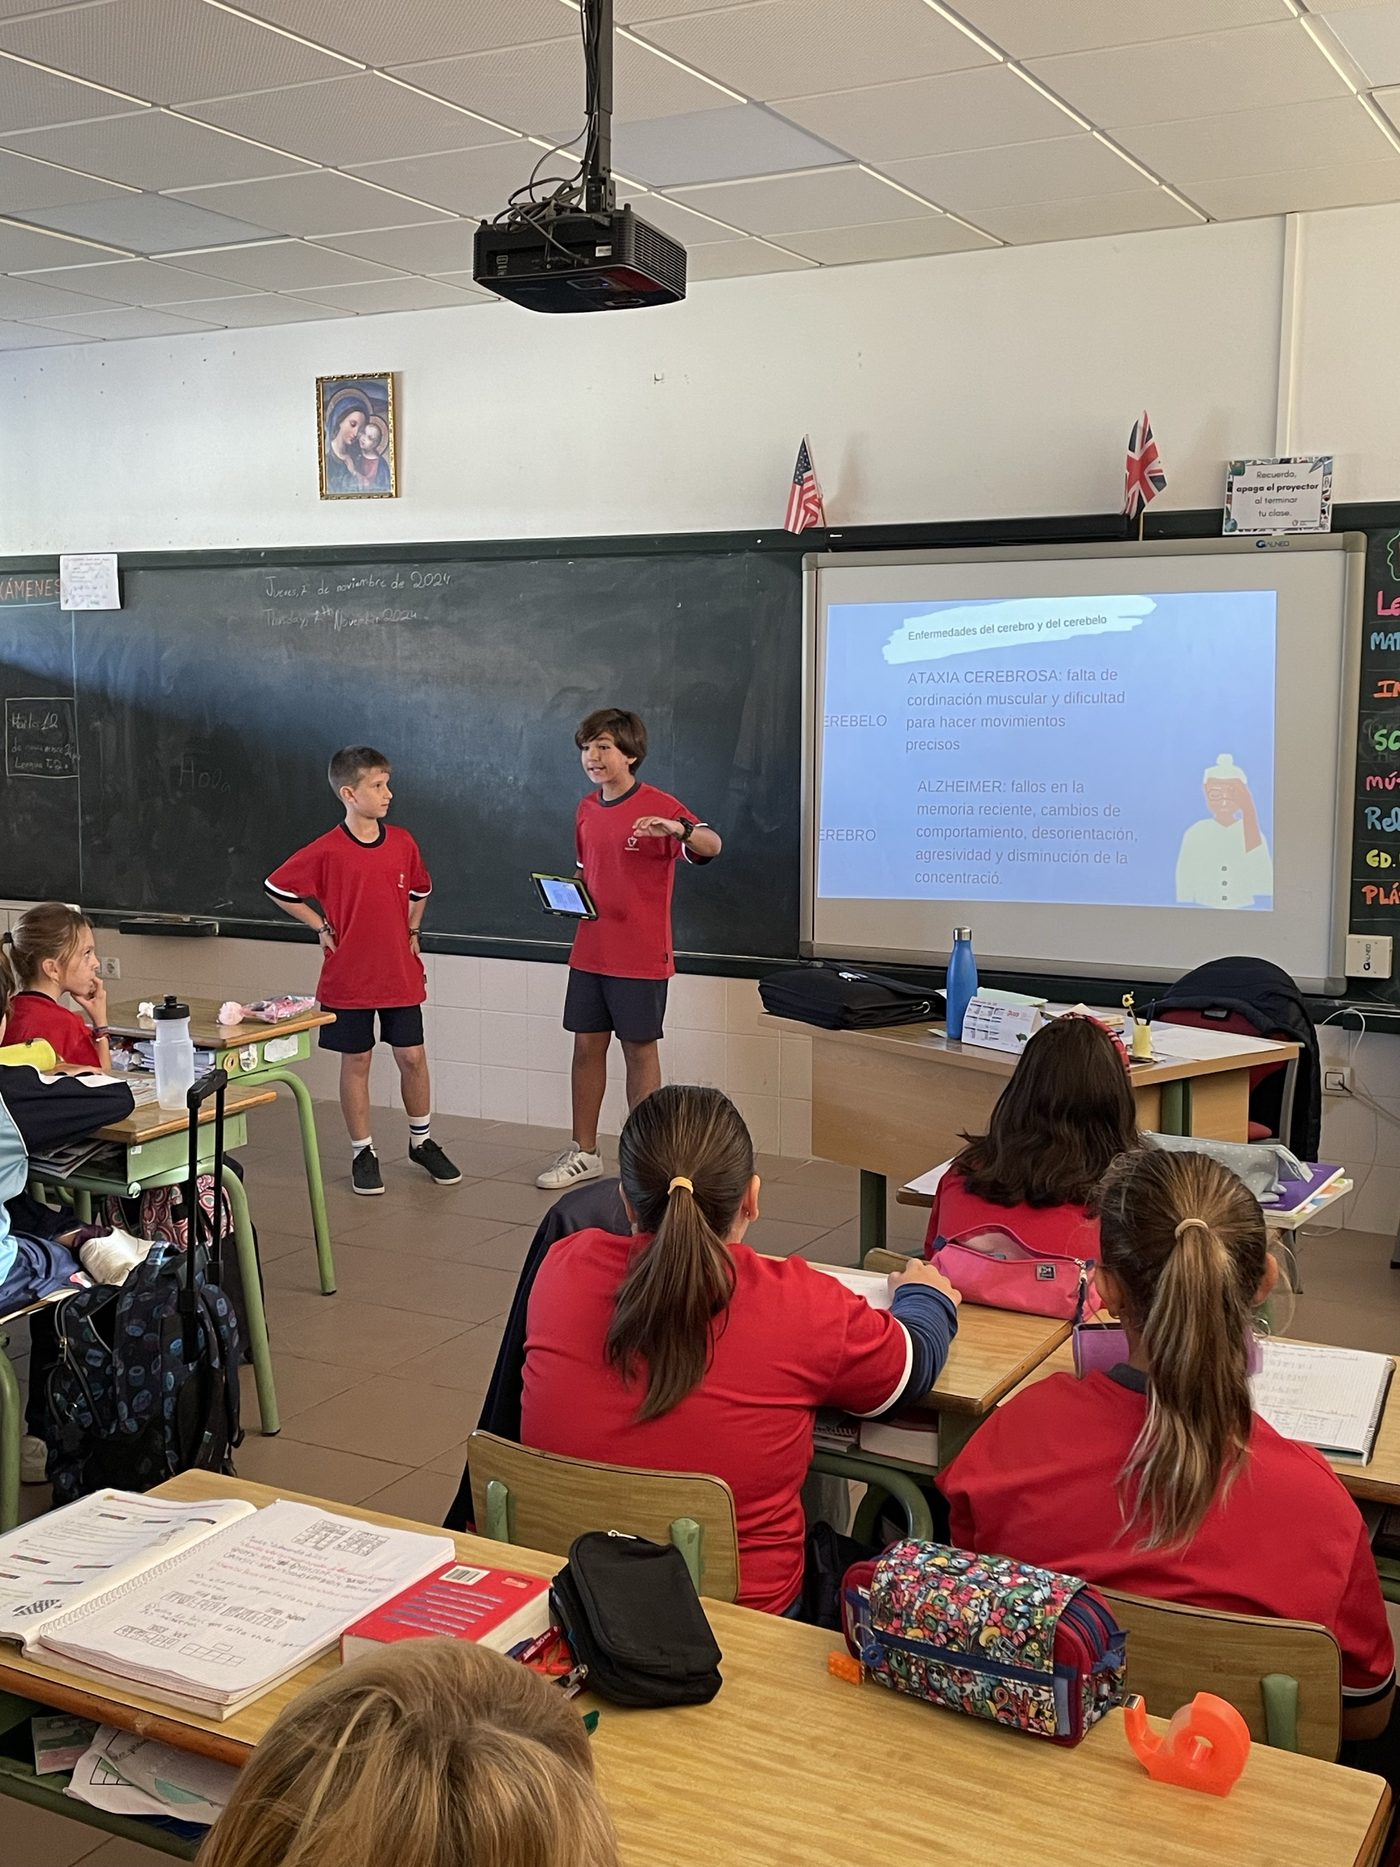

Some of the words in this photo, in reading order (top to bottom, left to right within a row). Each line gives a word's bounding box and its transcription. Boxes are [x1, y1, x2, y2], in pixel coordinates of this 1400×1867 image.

[1236, 485, 1265, 494] apaga
[1266, 483, 1275, 491] el
[1276, 483, 1319, 493] proyector
[1254, 497, 1262, 505] al
[317, 579, 330, 595] de
[391, 573, 405, 590] de
[908, 626, 978, 641] Enfermedades
[980, 624, 995, 635] del
[997, 621, 1035, 634] cerebro
[1037, 622, 1043, 632] y
[1045, 618, 1061, 629] del
[1063, 615, 1108, 628] cerebelo
[907, 671, 960, 684] ATAXIA
[964, 669, 1062, 684] CEREBROSA:
[1066, 669, 1096, 682] falta
[1100, 668, 1118, 681] de
[907, 692, 982, 706] cordinación
[986, 692, 1047, 705] muscular
[1051, 694, 1060, 707] y
[1063, 691, 1126, 705] dificultad
[906, 717, 935, 731] para
[939, 715, 977, 729] hacer
[980, 715, 1066, 728] movimientos
[905, 738, 960, 753] precisos
[917, 780, 1007, 793] ALZHEIMER:
[1010, 780, 1047, 793] fallos
[1050, 783, 1068, 793] en
[1072, 780, 1085, 794] la
[917, 803, 975, 816] memoria
[978, 803, 1037, 818] reciente,
[1040, 803, 1099, 817] cambios
[1103, 804, 1121, 817] de
[916, 826, 1028, 841] comportamiento,
[1031, 826, 1139, 843] desorientación,
[915, 848, 991, 864] agresividad
[995, 851, 1004, 865] y
[1007, 849, 1089, 864] disminución
[1093, 850, 1111, 864] de
[1115, 851, 1129, 865] la
[914, 871, 1003, 885] concentració.
[1361, 882, 1400, 906] PLÁ
